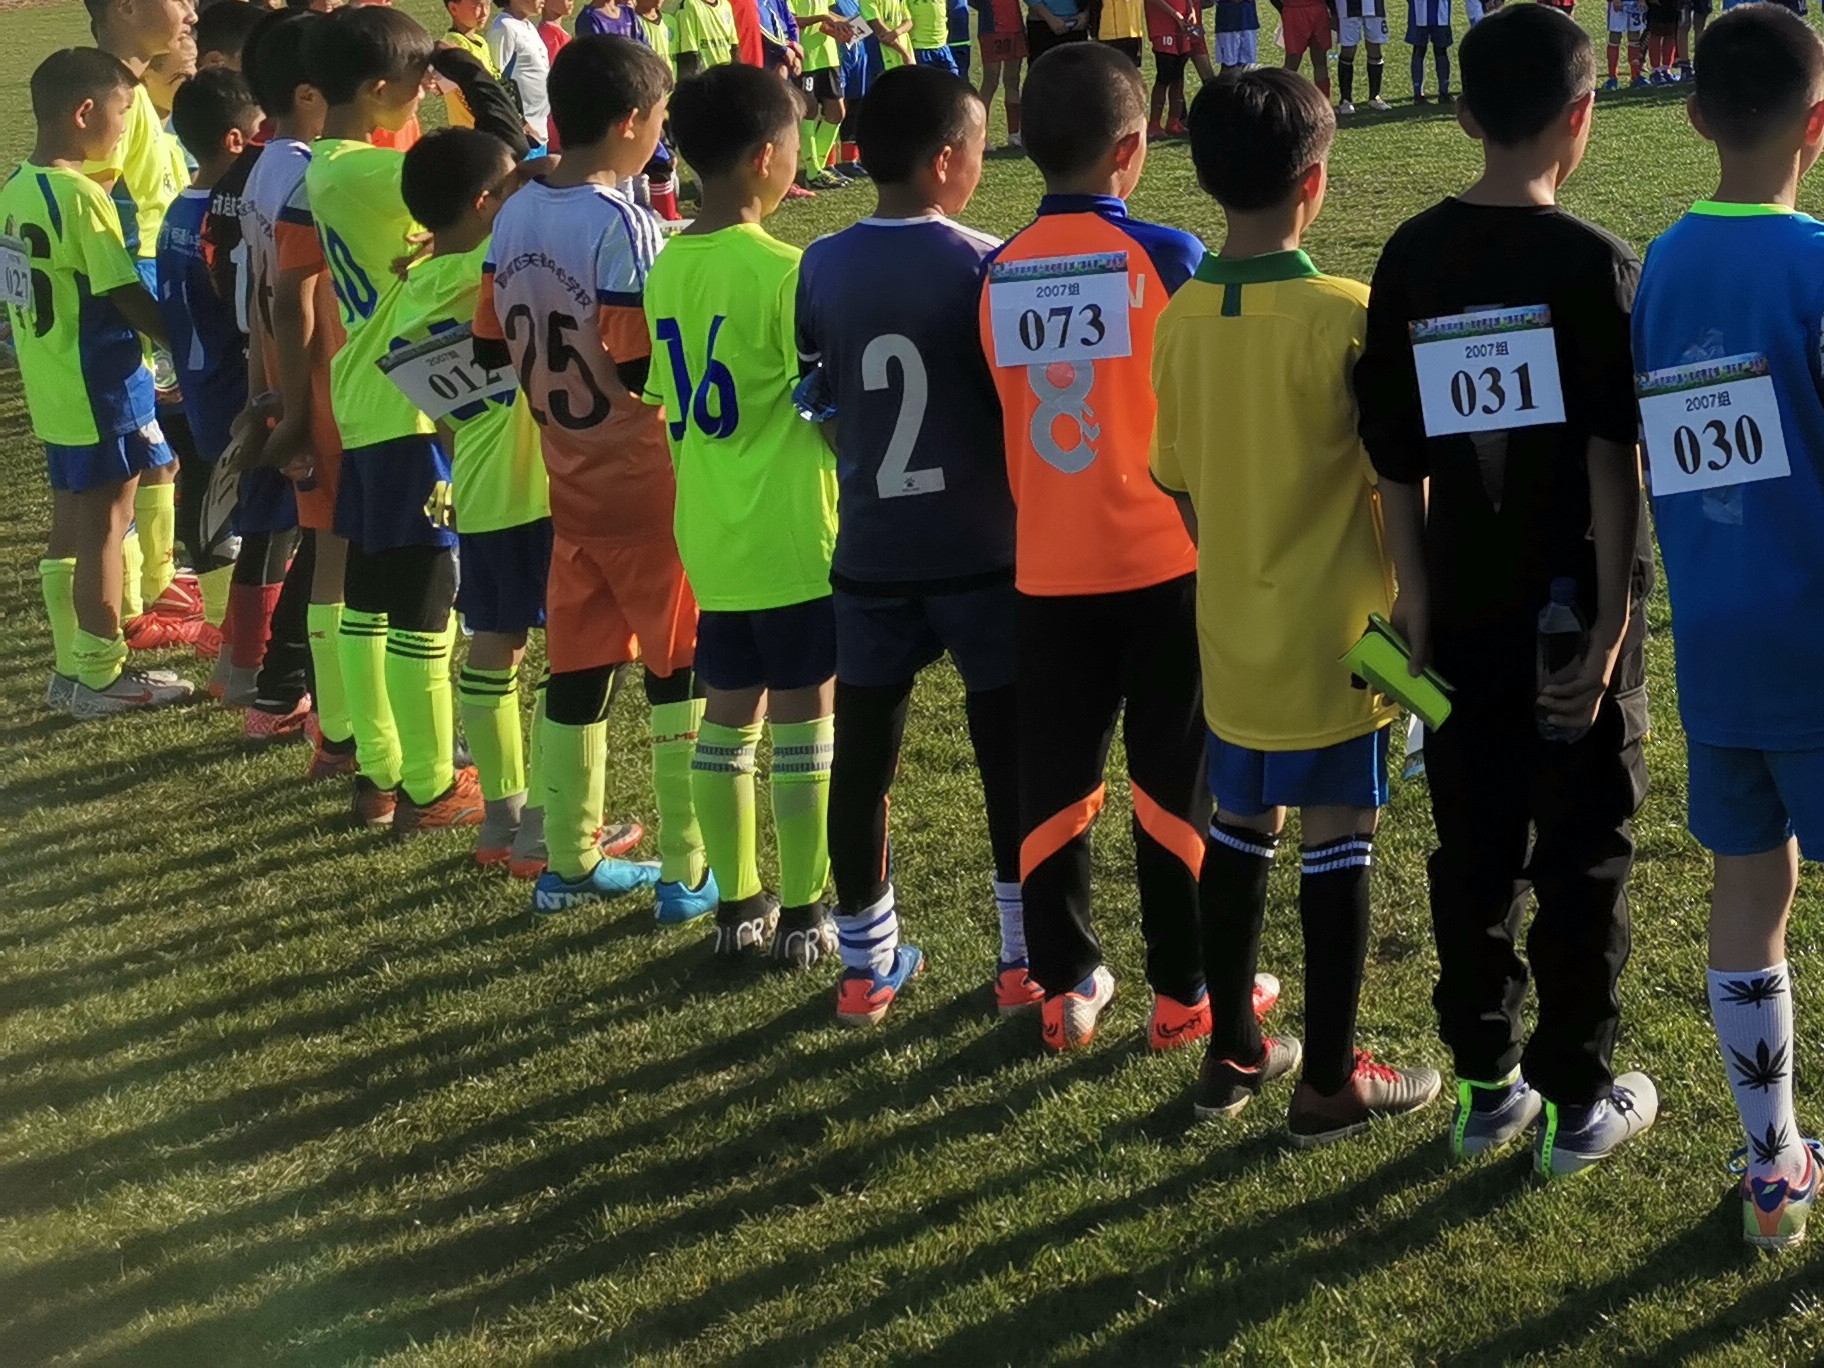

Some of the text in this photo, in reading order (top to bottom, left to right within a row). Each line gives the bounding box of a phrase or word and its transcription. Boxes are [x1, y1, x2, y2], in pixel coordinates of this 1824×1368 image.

[1019, 303, 1106, 351] 073
[505, 304, 611, 430] 25
[655, 314, 740, 441] 16
[1451, 361, 1540, 417] 031
[862, 334, 946, 499] 2
[1686, 390, 1732, 412] 2007组
[1674, 414, 1762, 475] 030
